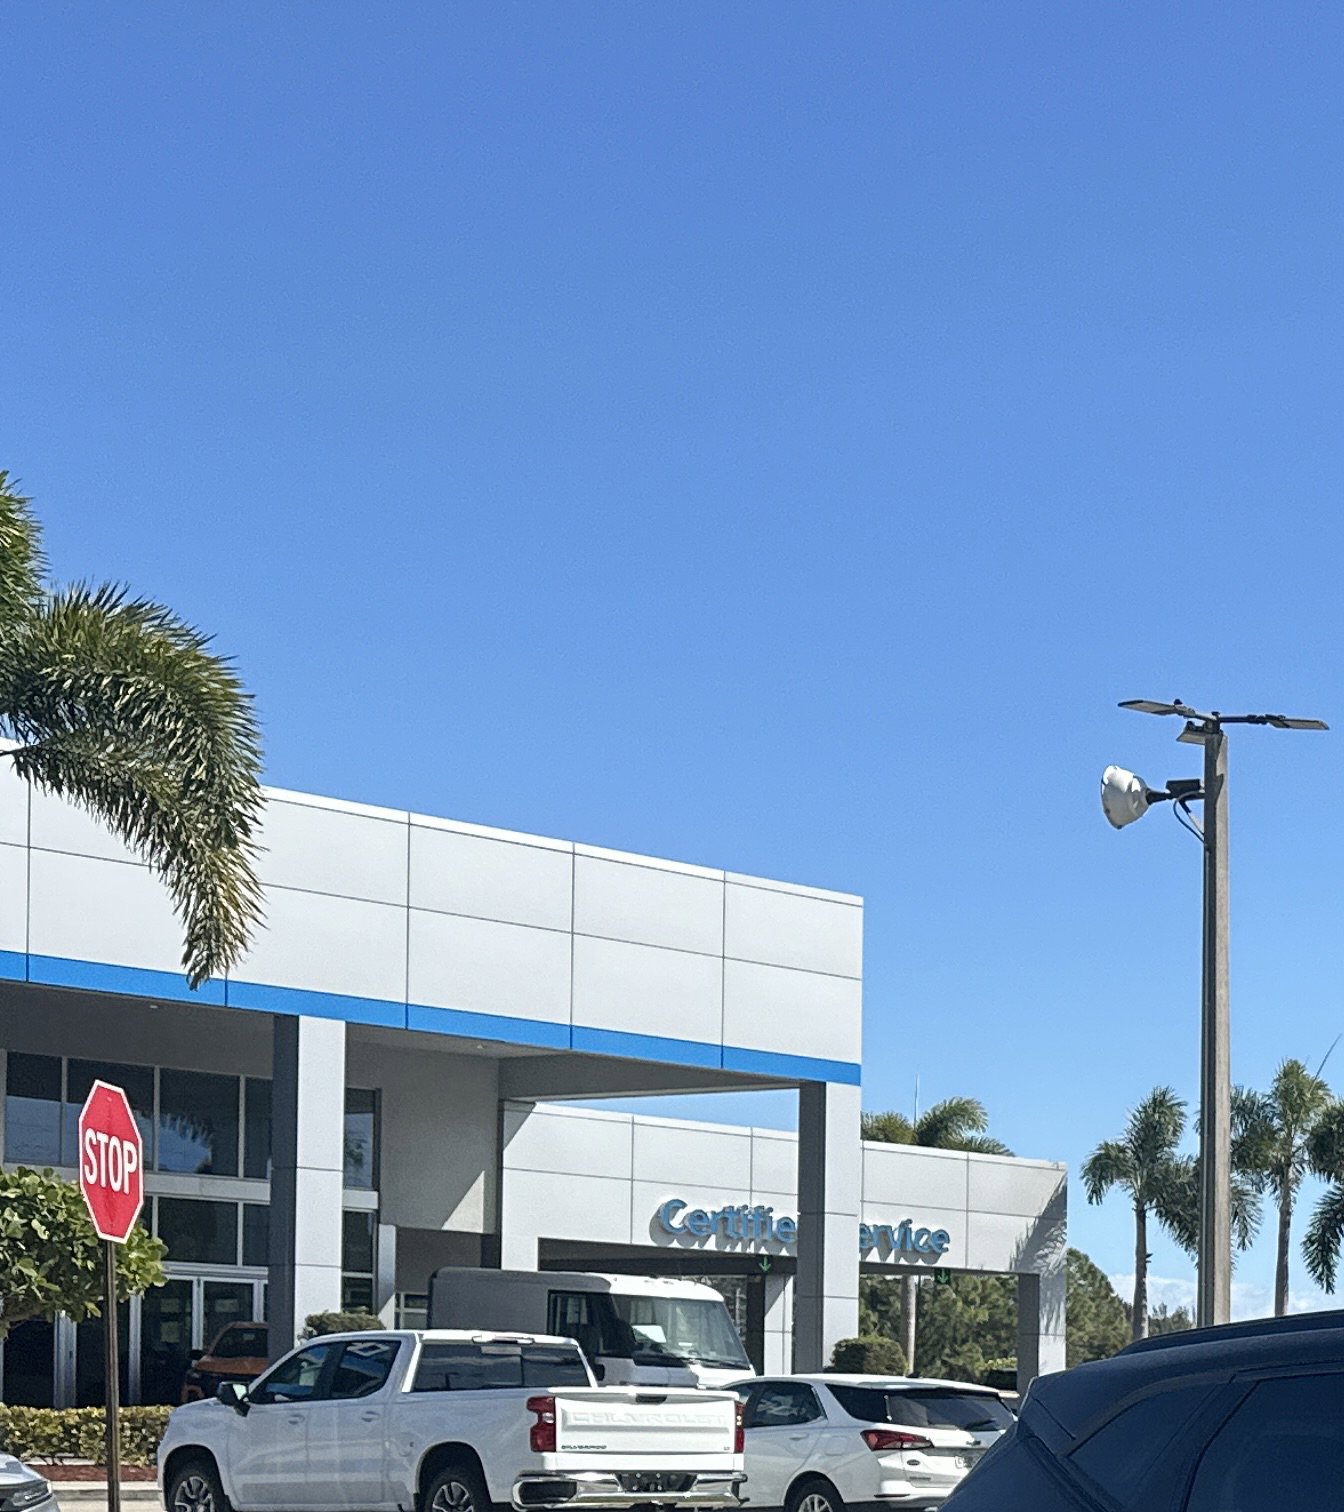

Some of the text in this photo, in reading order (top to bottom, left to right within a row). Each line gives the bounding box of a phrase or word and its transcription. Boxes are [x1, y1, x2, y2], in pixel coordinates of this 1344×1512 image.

[84, 1127, 138, 1195] STOP
[659, 1198, 951, 1255] Certifie ervice
